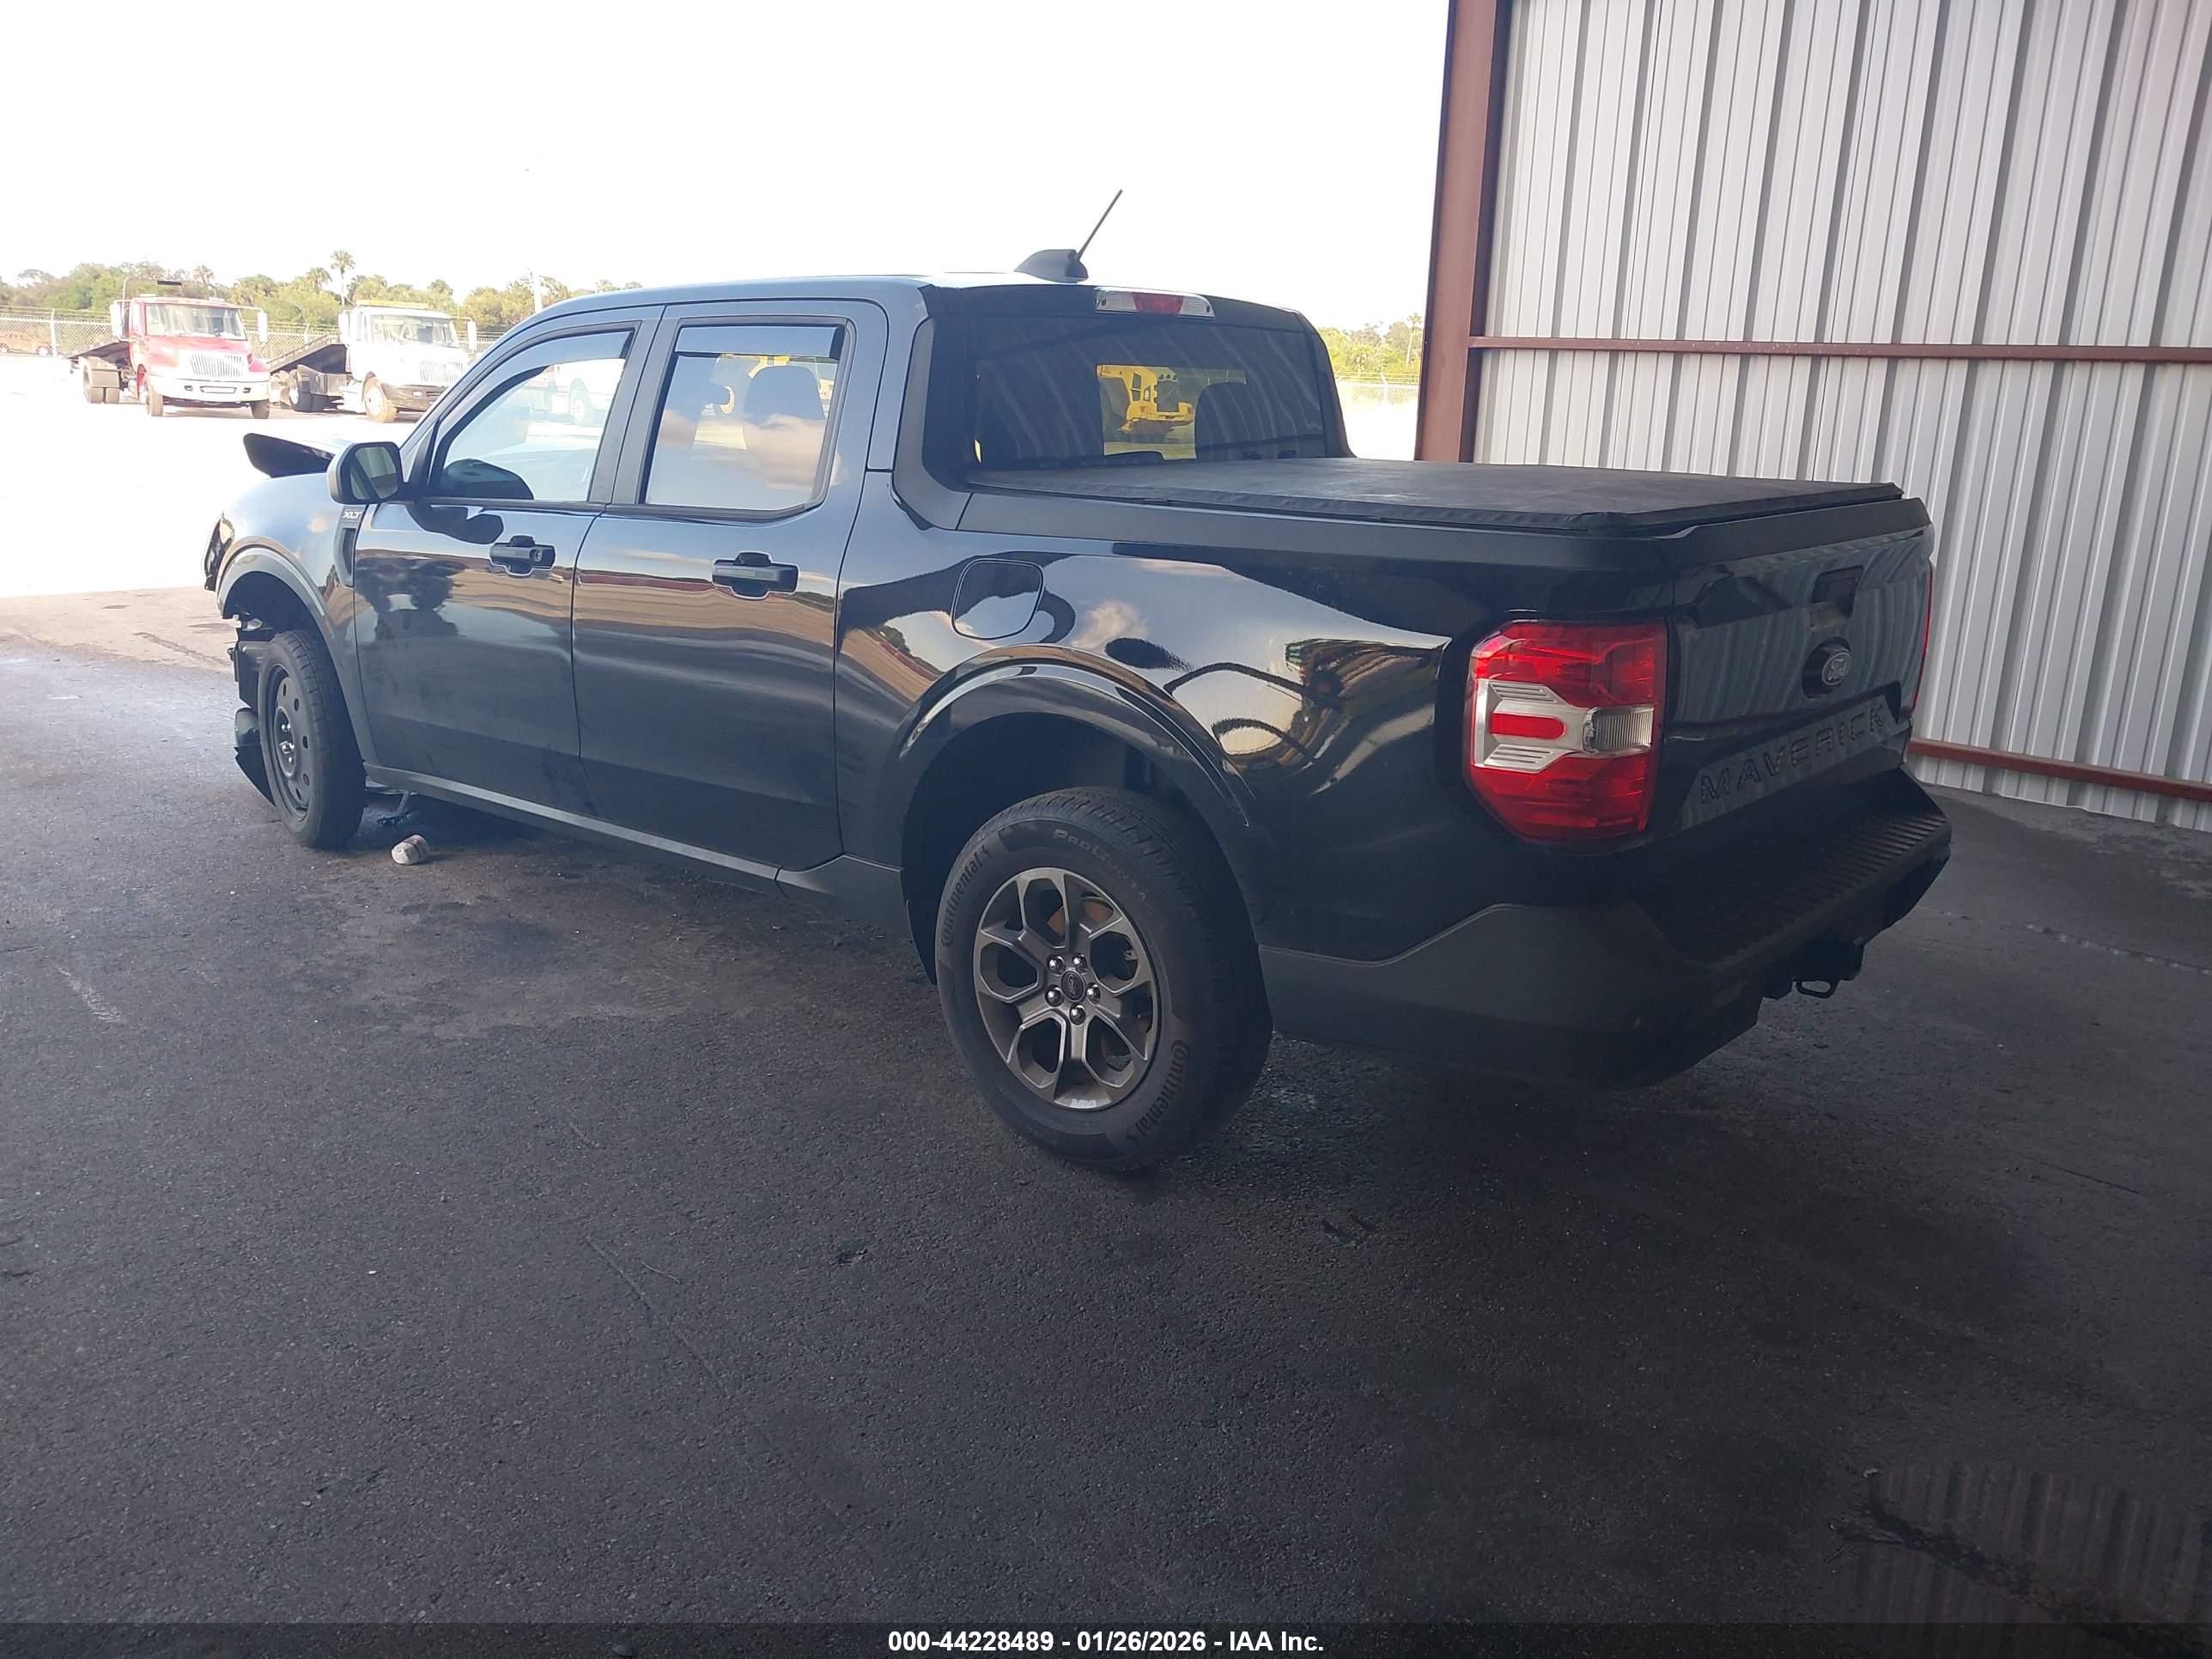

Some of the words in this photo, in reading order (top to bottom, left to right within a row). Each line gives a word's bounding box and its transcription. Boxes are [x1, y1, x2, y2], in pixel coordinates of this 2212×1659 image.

[343, 511, 362, 520] XLT
[1699, 704, 1884, 805] MAVERICK
[940, 850, 983, 947] Continental
[1134, 1039, 1188, 1137] Continental
